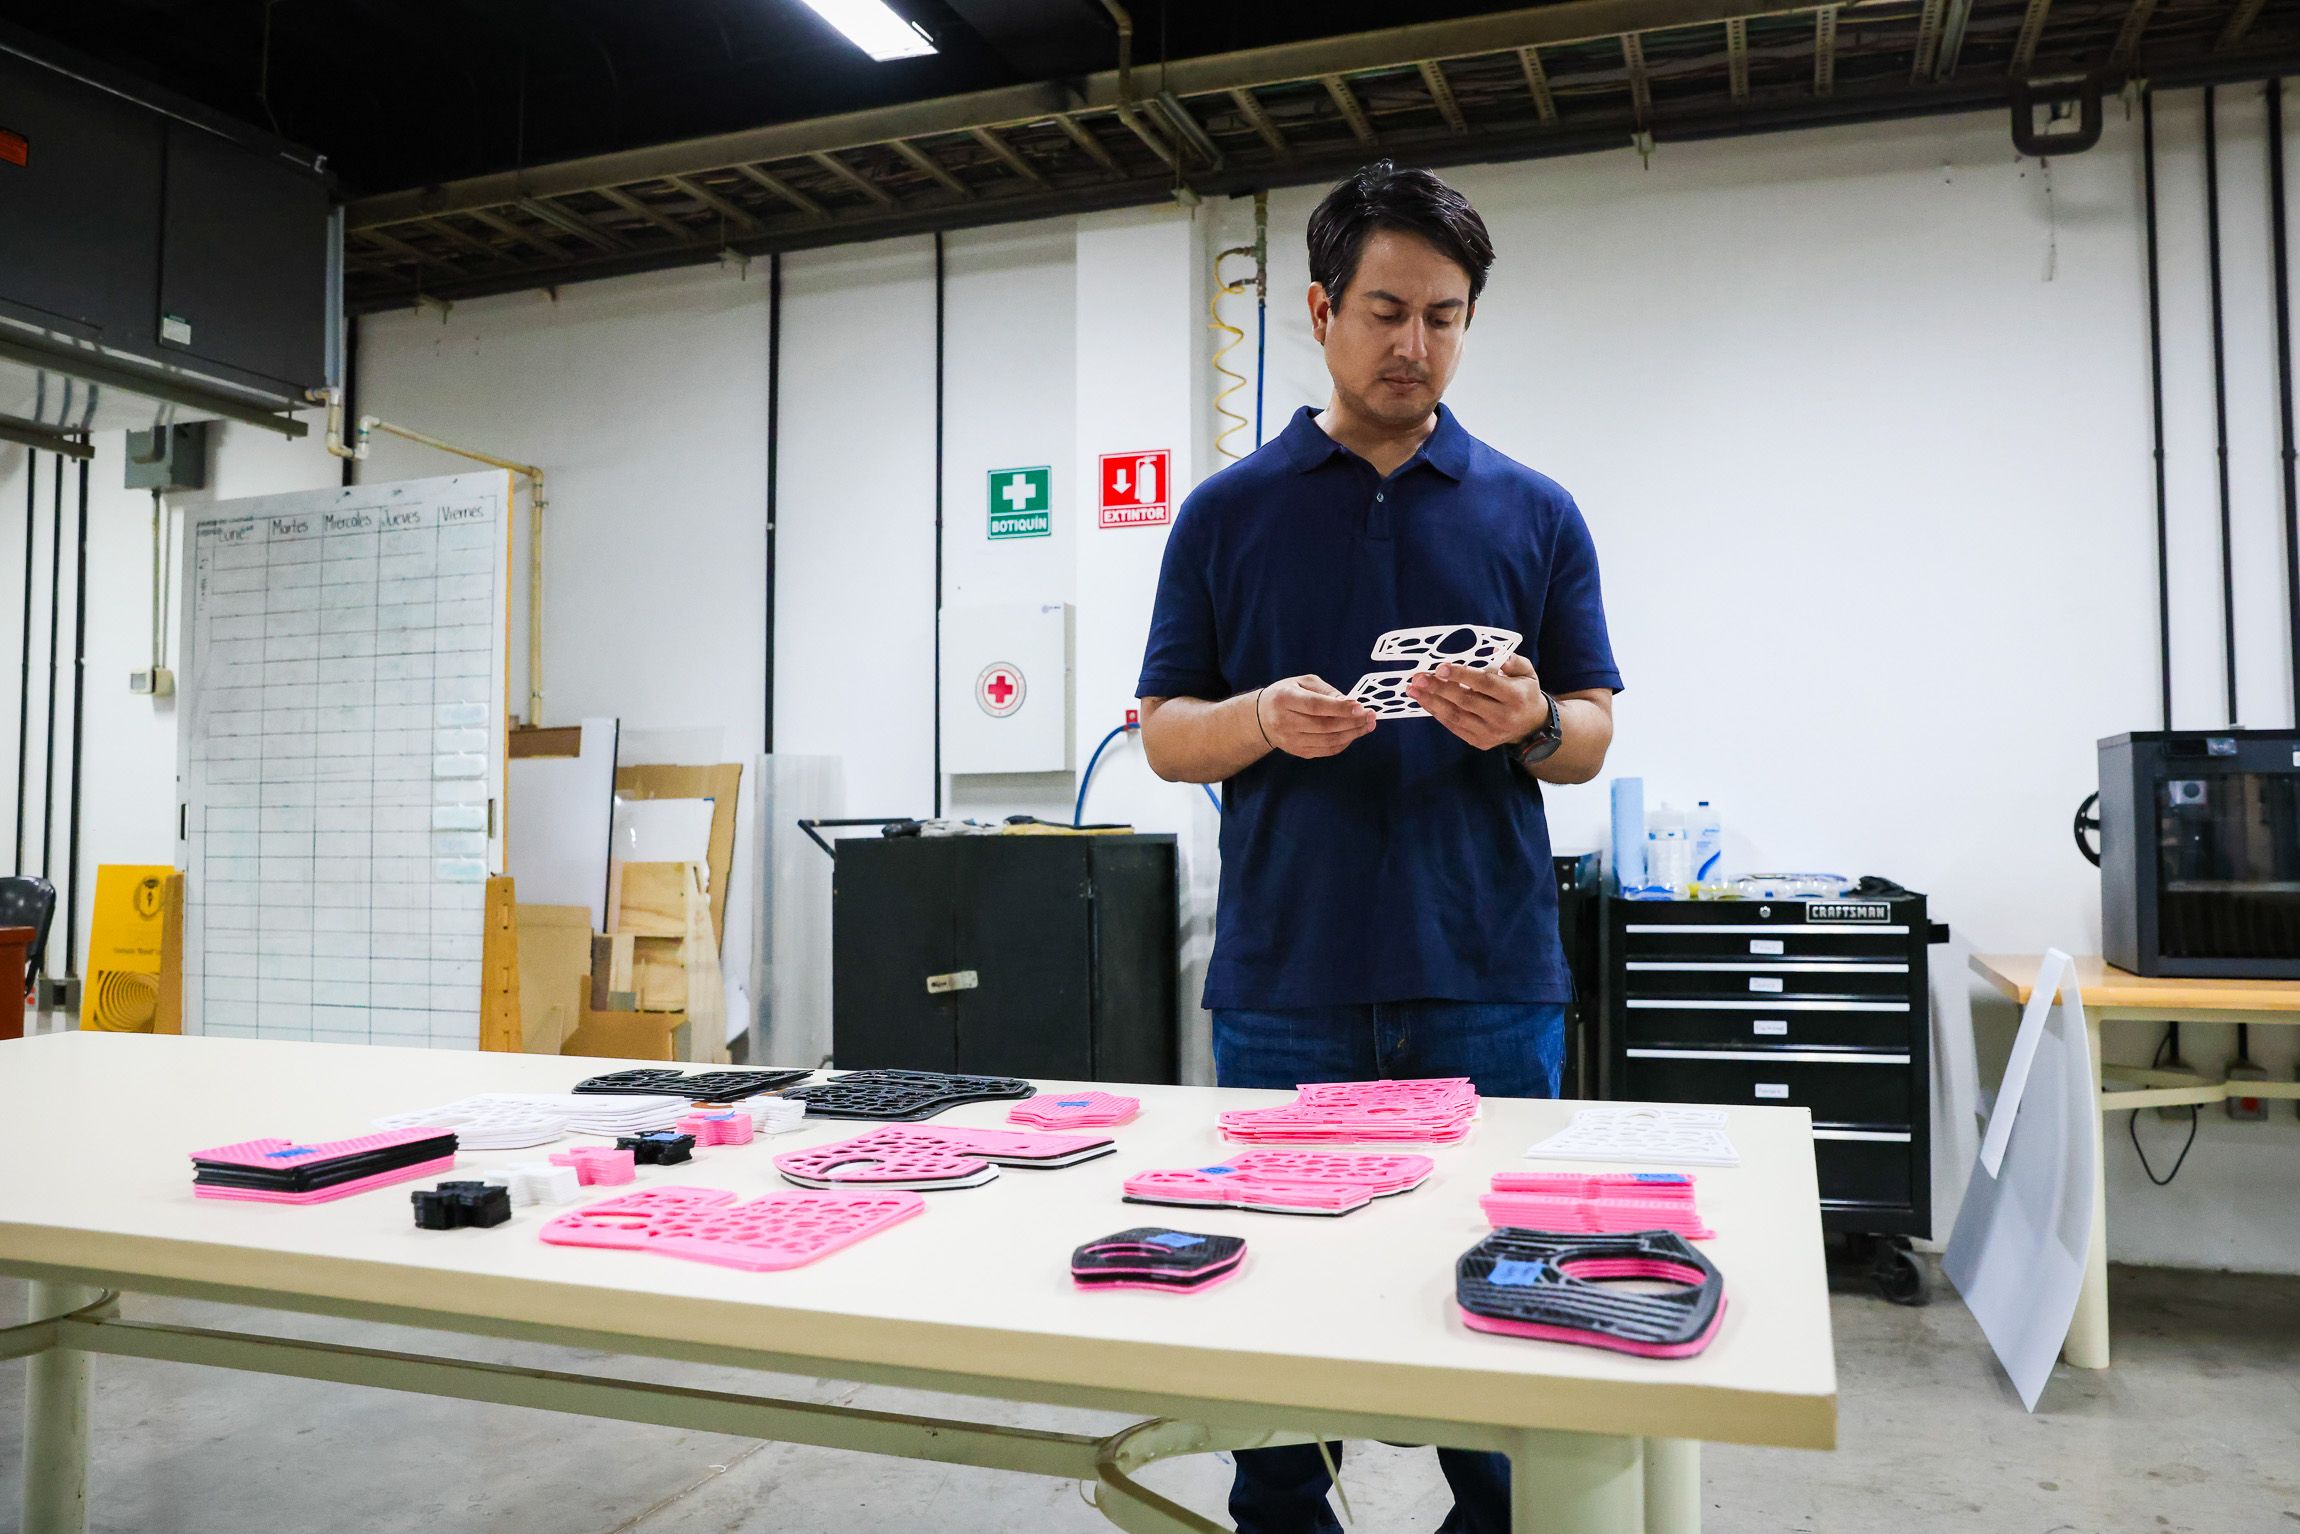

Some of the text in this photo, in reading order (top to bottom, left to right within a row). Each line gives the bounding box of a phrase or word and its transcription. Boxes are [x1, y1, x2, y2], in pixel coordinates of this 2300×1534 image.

[272, 519, 308, 536] Martes
[442, 505, 484, 522] Viernes
[1104, 507, 1165, 522] EXTINTOR
[992, 516, 1047, 532] BOTIQUÍN
[1812, 906, 1885, 918] CRAFTSMAN
